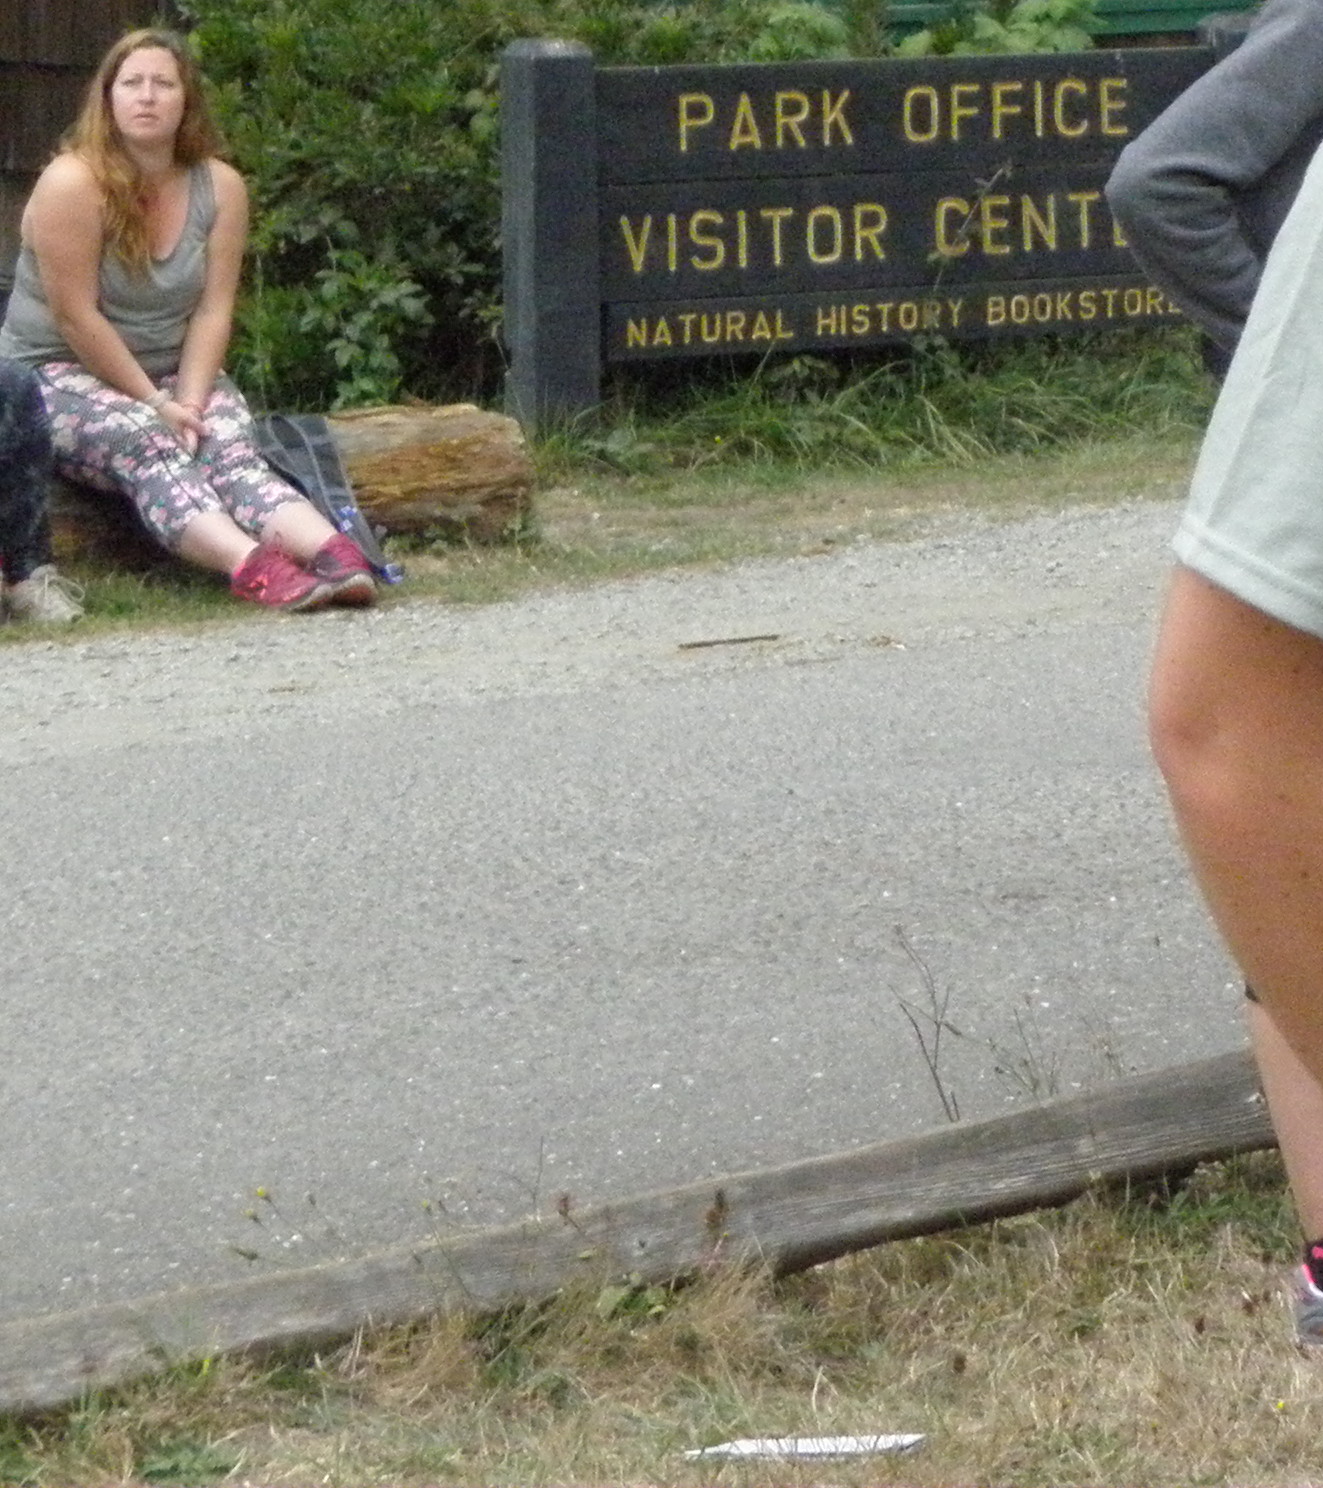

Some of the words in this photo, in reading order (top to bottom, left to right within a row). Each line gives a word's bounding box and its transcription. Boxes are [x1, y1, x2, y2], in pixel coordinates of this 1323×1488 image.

[678, 88, 854, 152] PARK
[903, 77, 1129, 143] OFFICE
[620, 202, 887, 273] VISITOR
[626, 309, 794, 349] NATURAL
[817, 298, 963, 337] HISTORY
